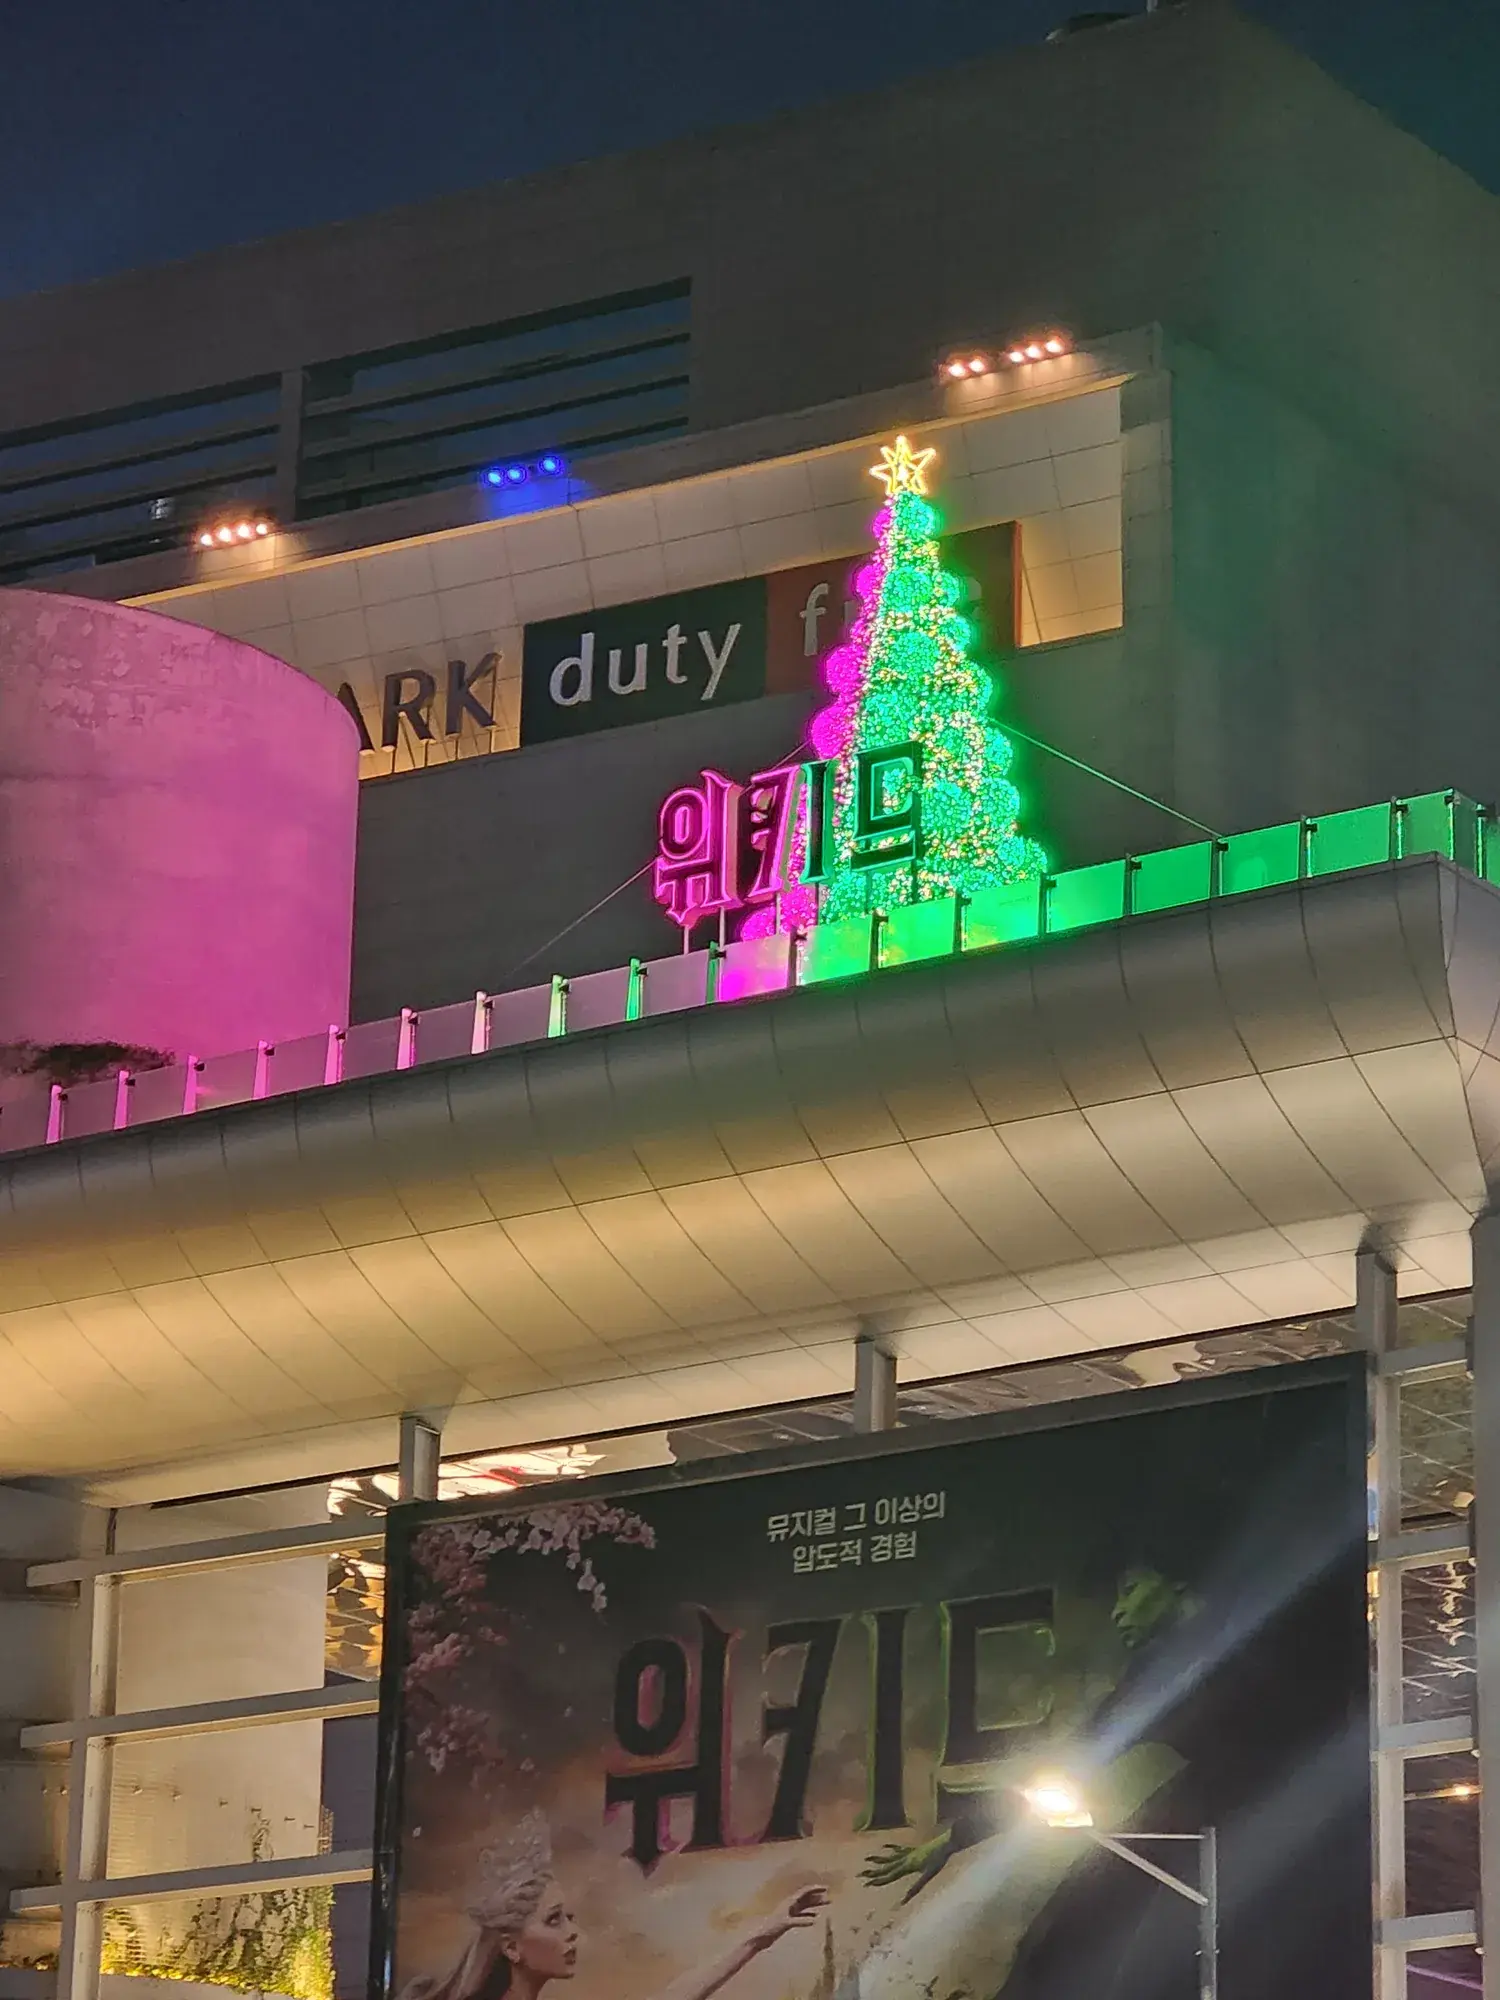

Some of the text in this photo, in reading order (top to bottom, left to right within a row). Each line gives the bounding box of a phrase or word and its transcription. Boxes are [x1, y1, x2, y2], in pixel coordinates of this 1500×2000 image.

[549, 622, 742, 706] duty
[653, 740, 922, 928] 위키드
[767, 1491, 946, 1542] 뮤지컬 그 이상의
[793, 1531, 917, 1573] 압도적 경험
[602, 1587, 1058, 1879] 위키드
